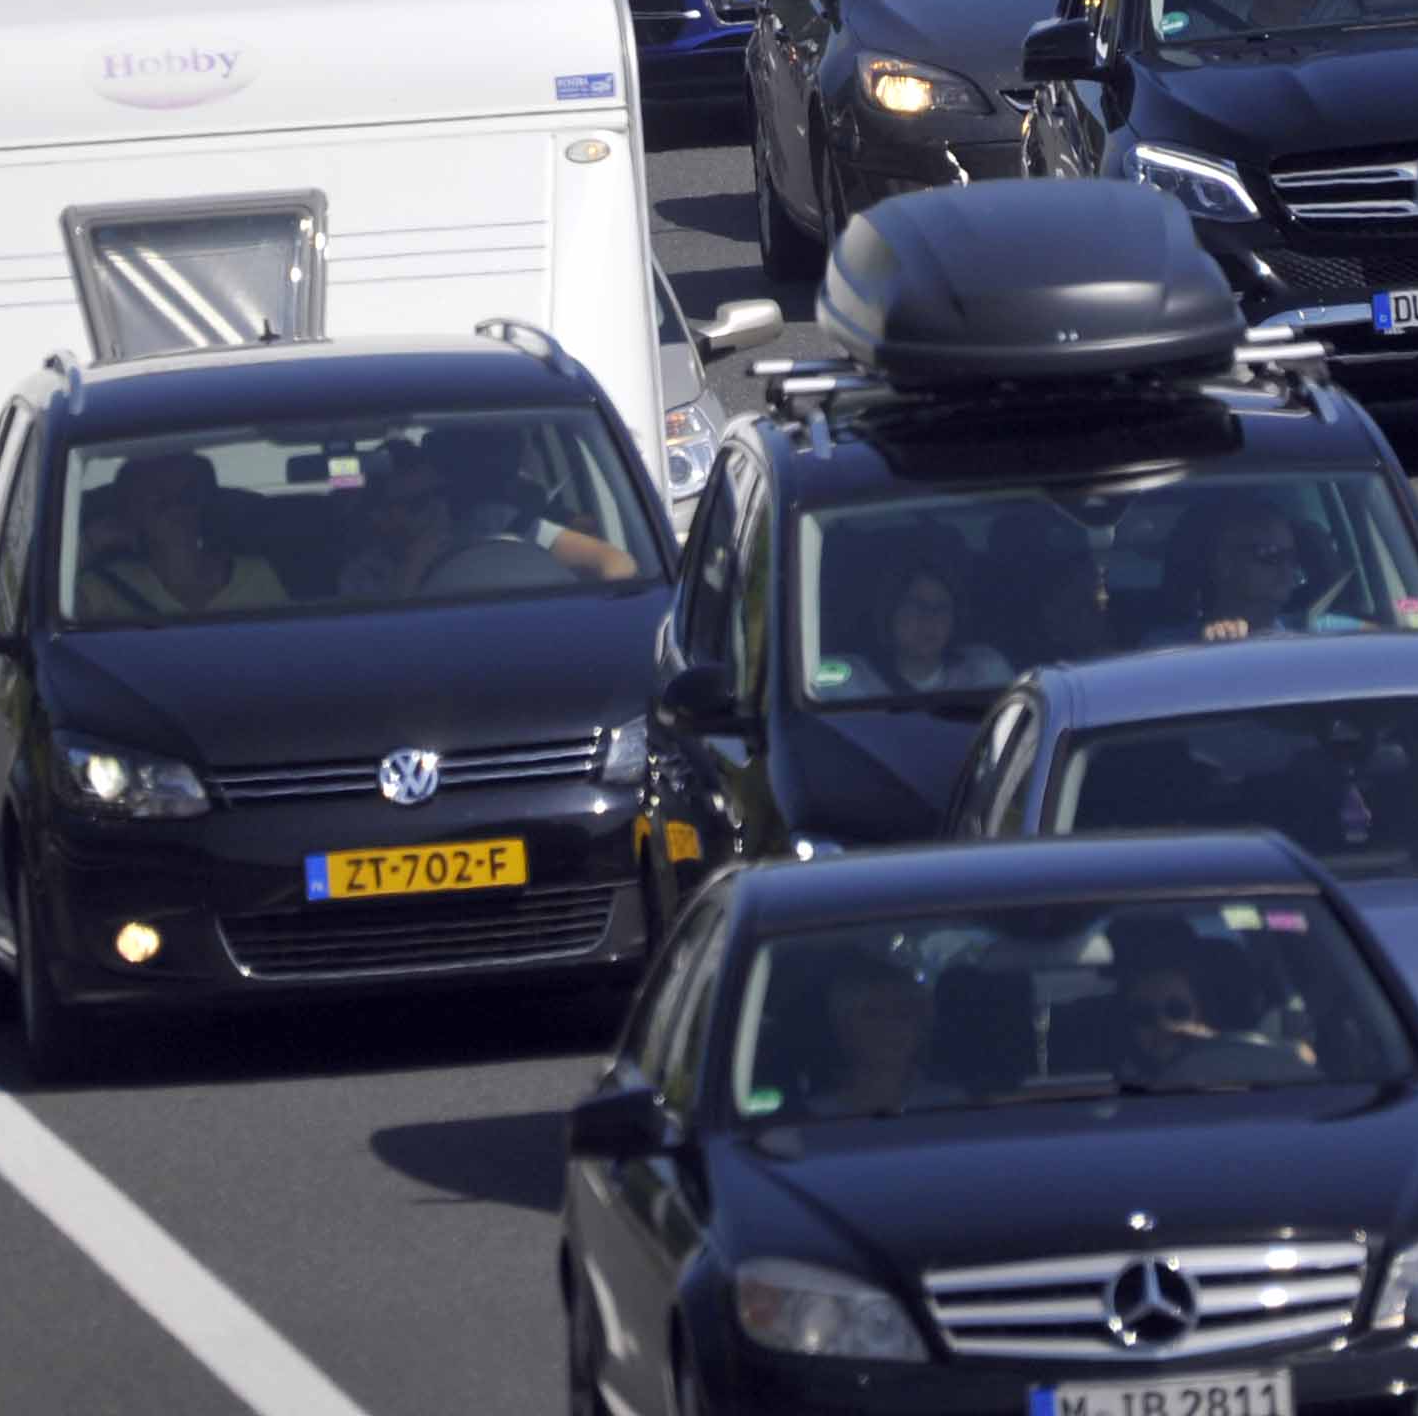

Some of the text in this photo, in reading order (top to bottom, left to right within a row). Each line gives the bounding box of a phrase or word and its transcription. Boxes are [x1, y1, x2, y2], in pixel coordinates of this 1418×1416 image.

[101, 48, 245, 80] Hobby
[346, 847, 508, 893] ZT-702-F
[1181, 1384, 1281, 1416] 2811
